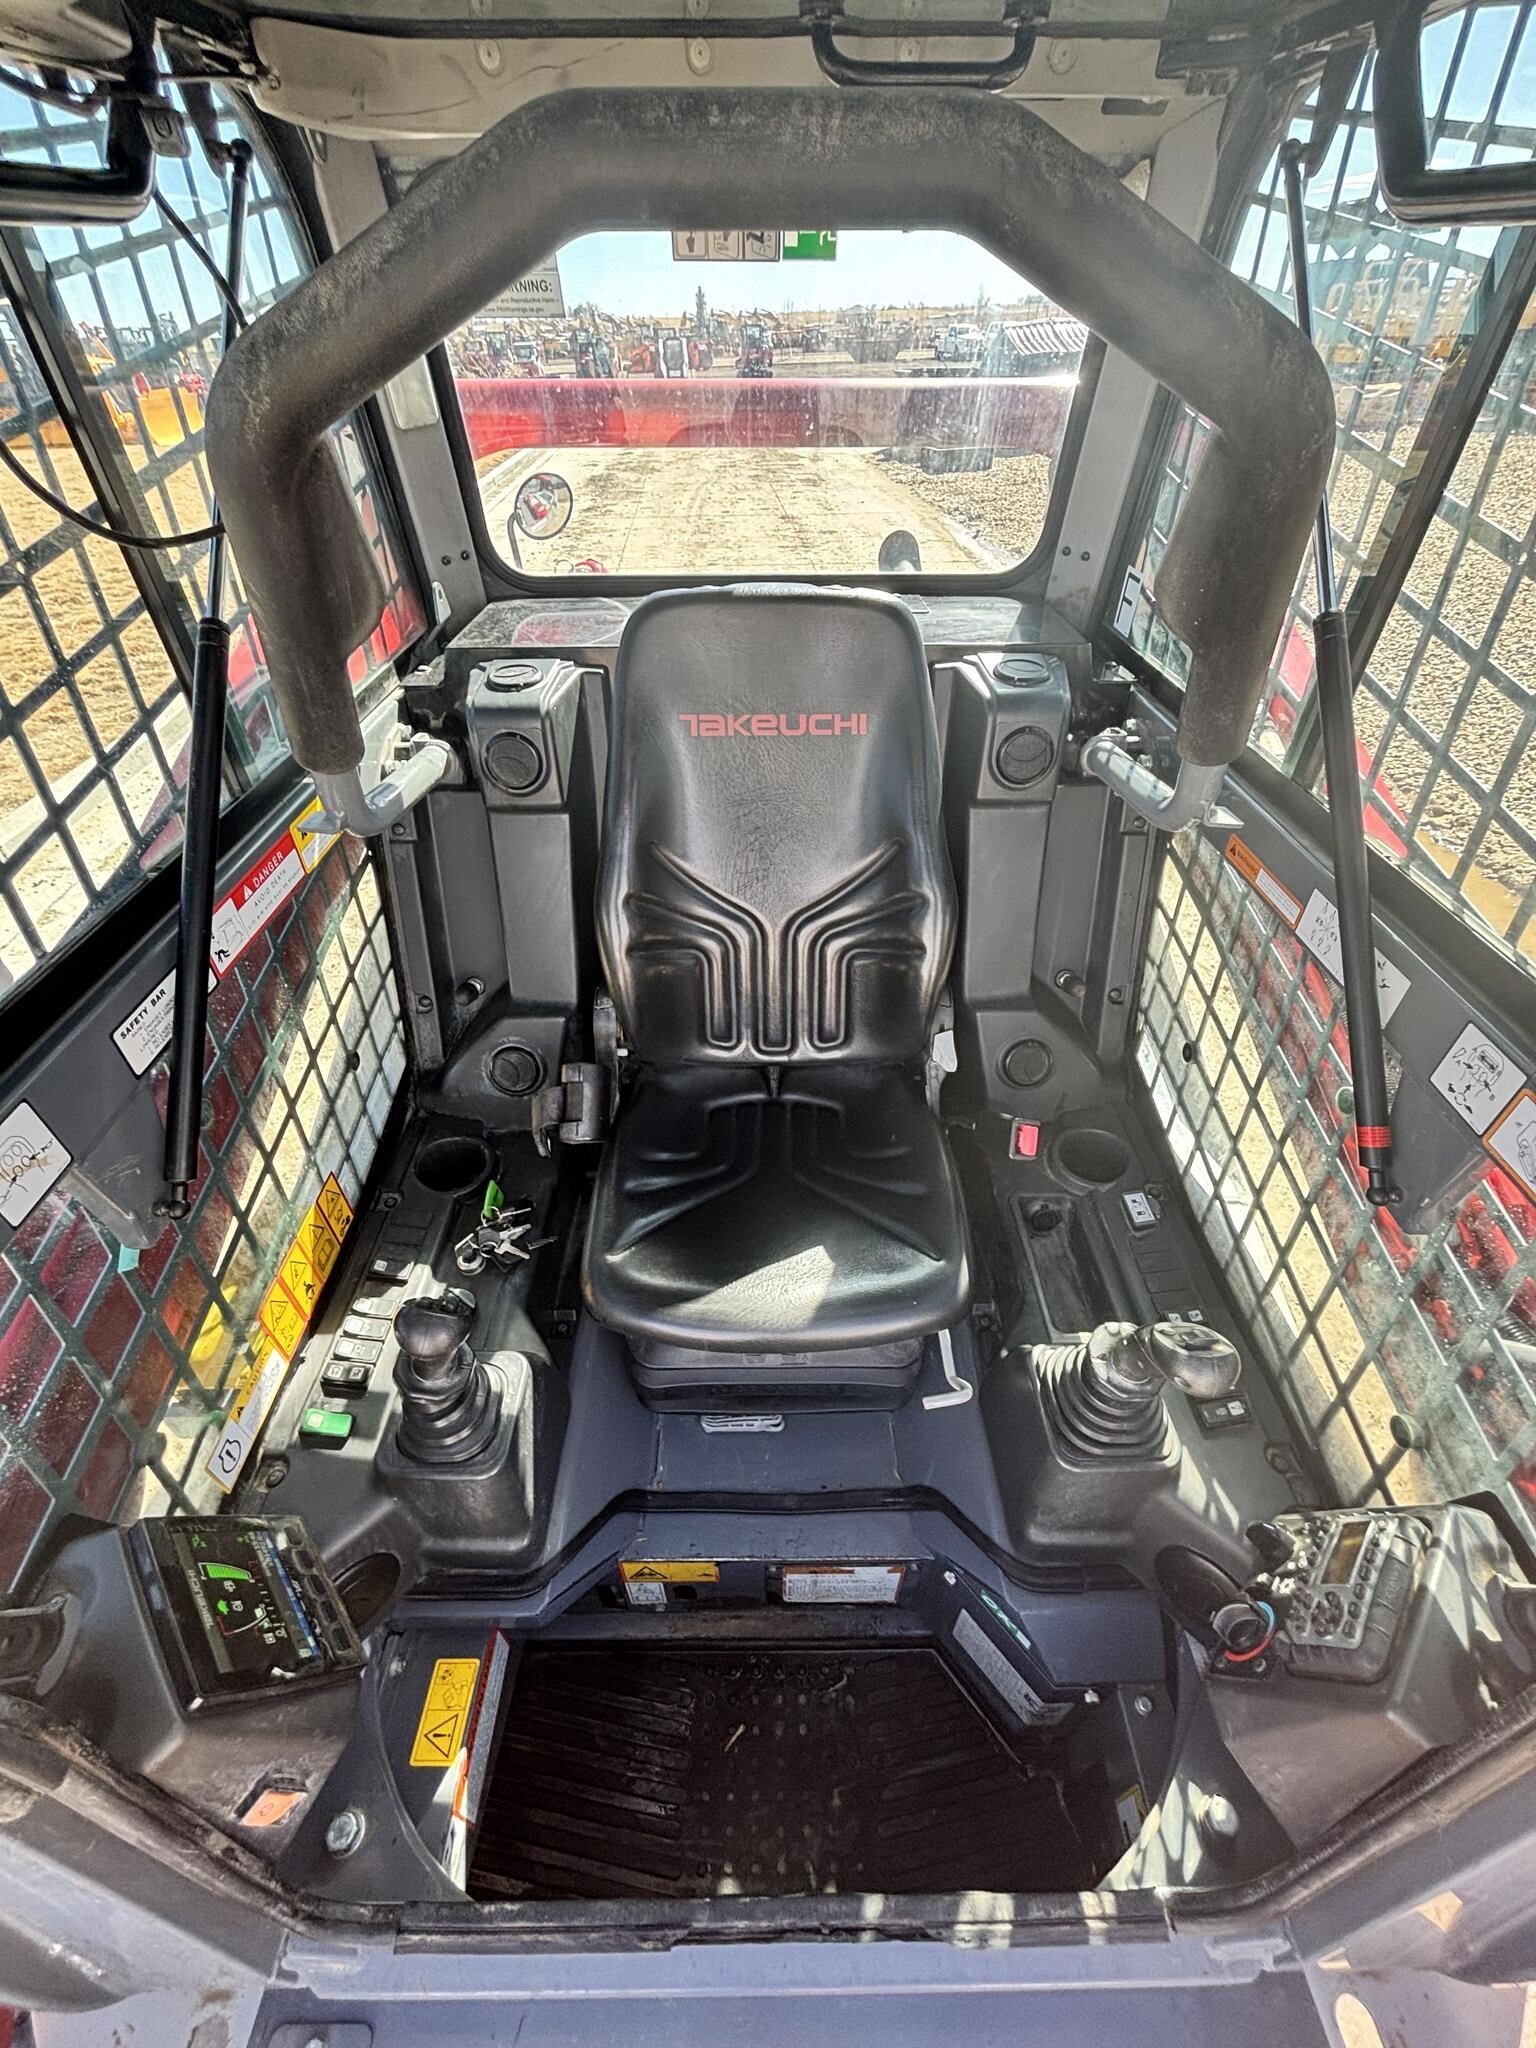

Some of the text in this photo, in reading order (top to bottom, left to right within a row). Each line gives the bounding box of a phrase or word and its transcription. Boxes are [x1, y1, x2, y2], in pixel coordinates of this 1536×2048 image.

[252, 850, 284, 889] DANGER
[254, 869, 287, 908] AVOID DEATH
[120, 1006, 149, 1040] SAFETY
[150, 988, 167, 1007] BAR
